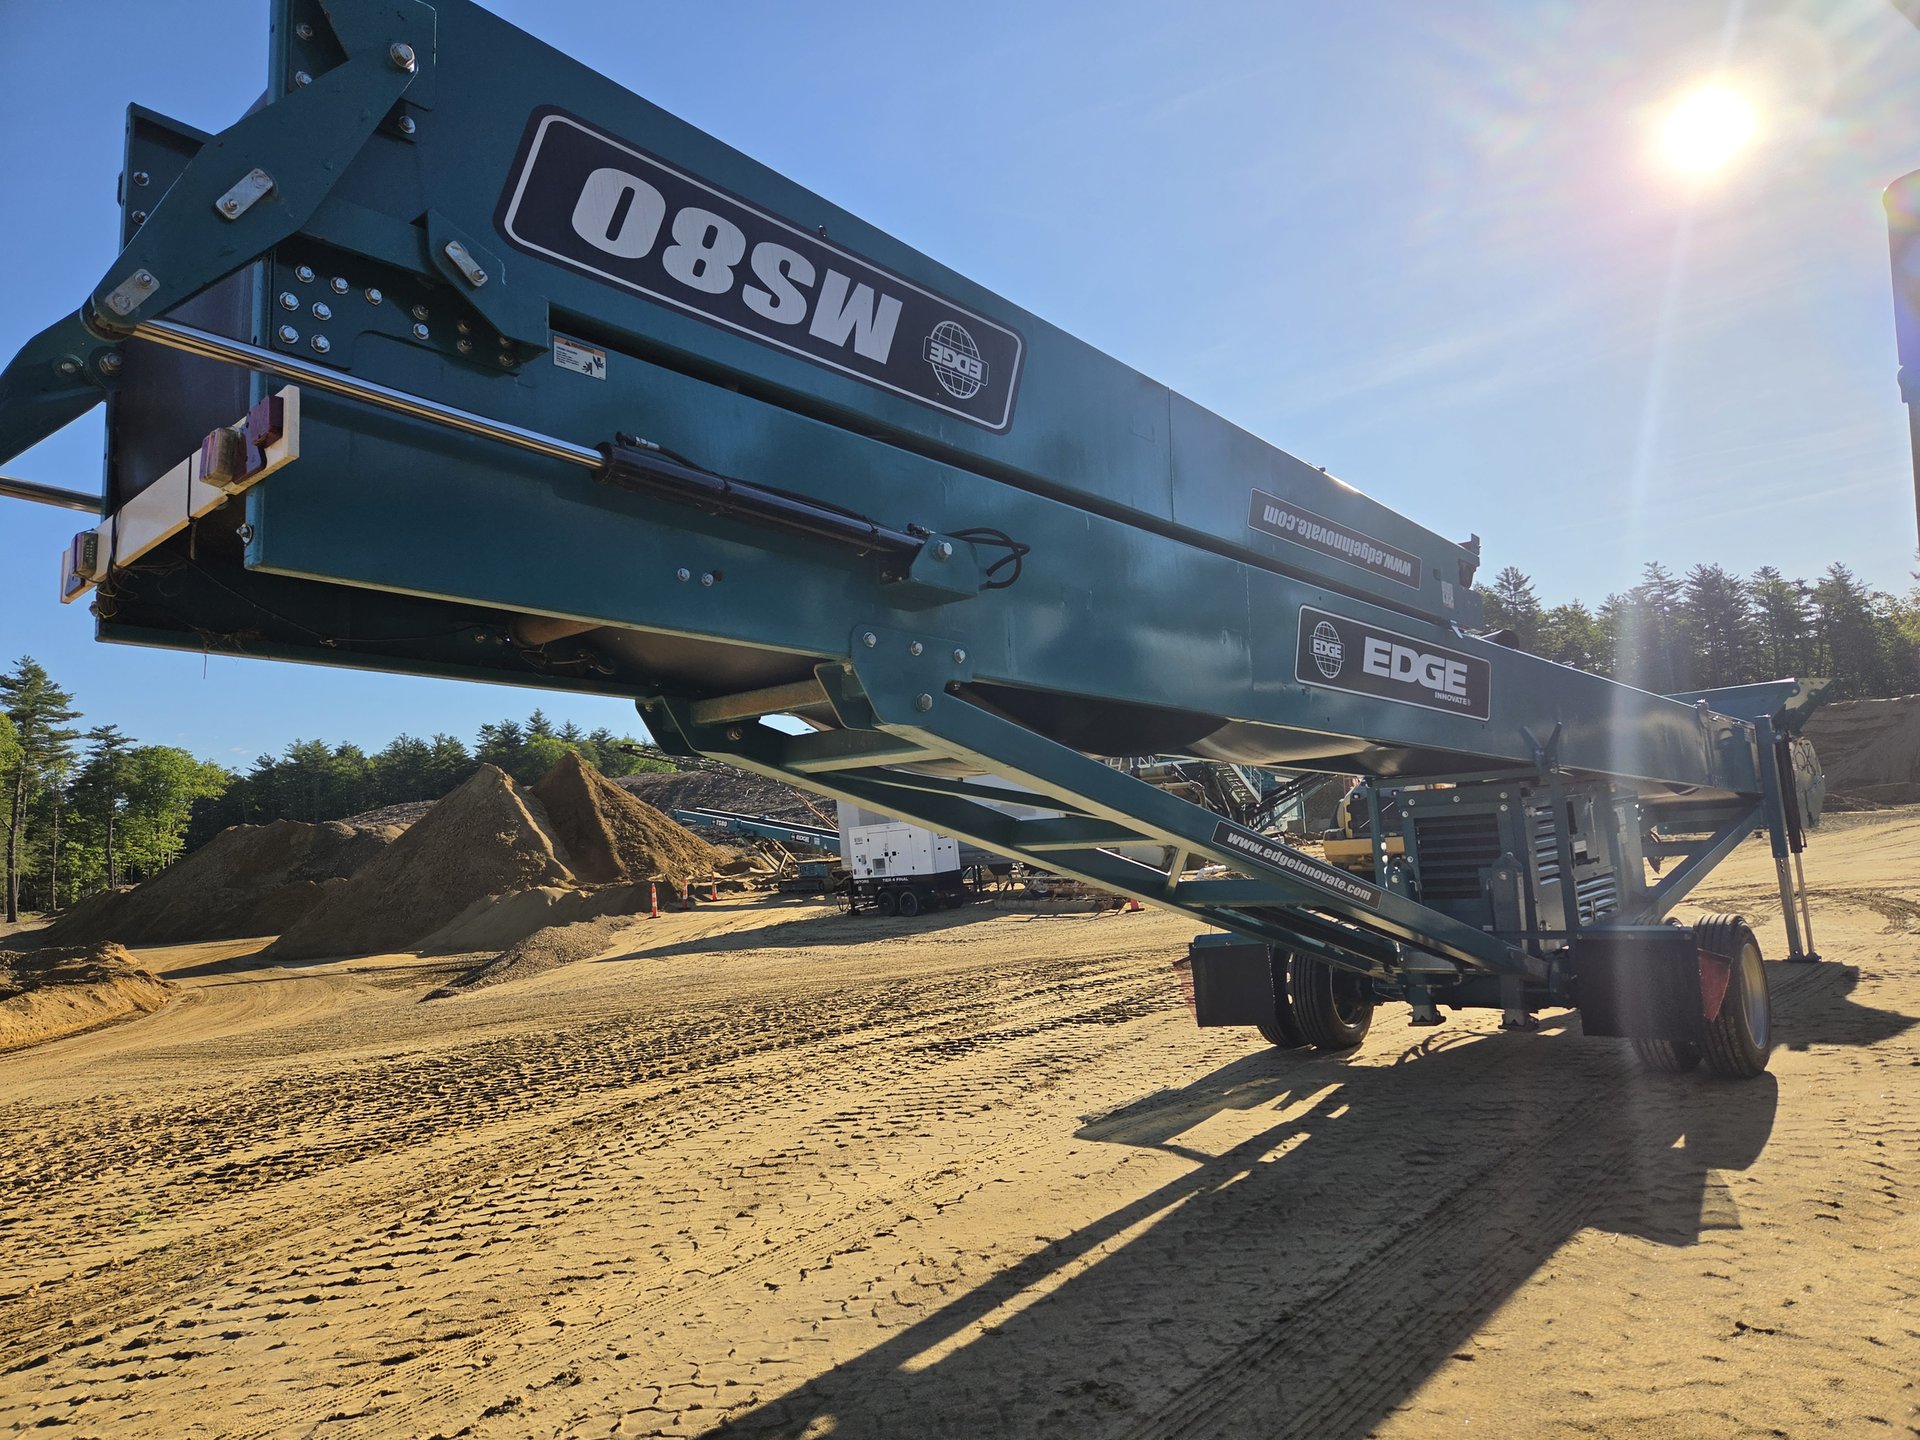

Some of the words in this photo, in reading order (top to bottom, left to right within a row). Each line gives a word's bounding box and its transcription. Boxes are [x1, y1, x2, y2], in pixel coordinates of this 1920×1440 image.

[572, 168, 903, 365] MS80
[929, 341, 982, 380] EDGE
[1263, 504, 1411, 577] www.edgeinnovate.com
[1312, 638, 1342, 658] EDGE
[1363, 636, 1468, 697] EDGE
[1226, 831, 1372, 901] www.edgeinnovate.com
